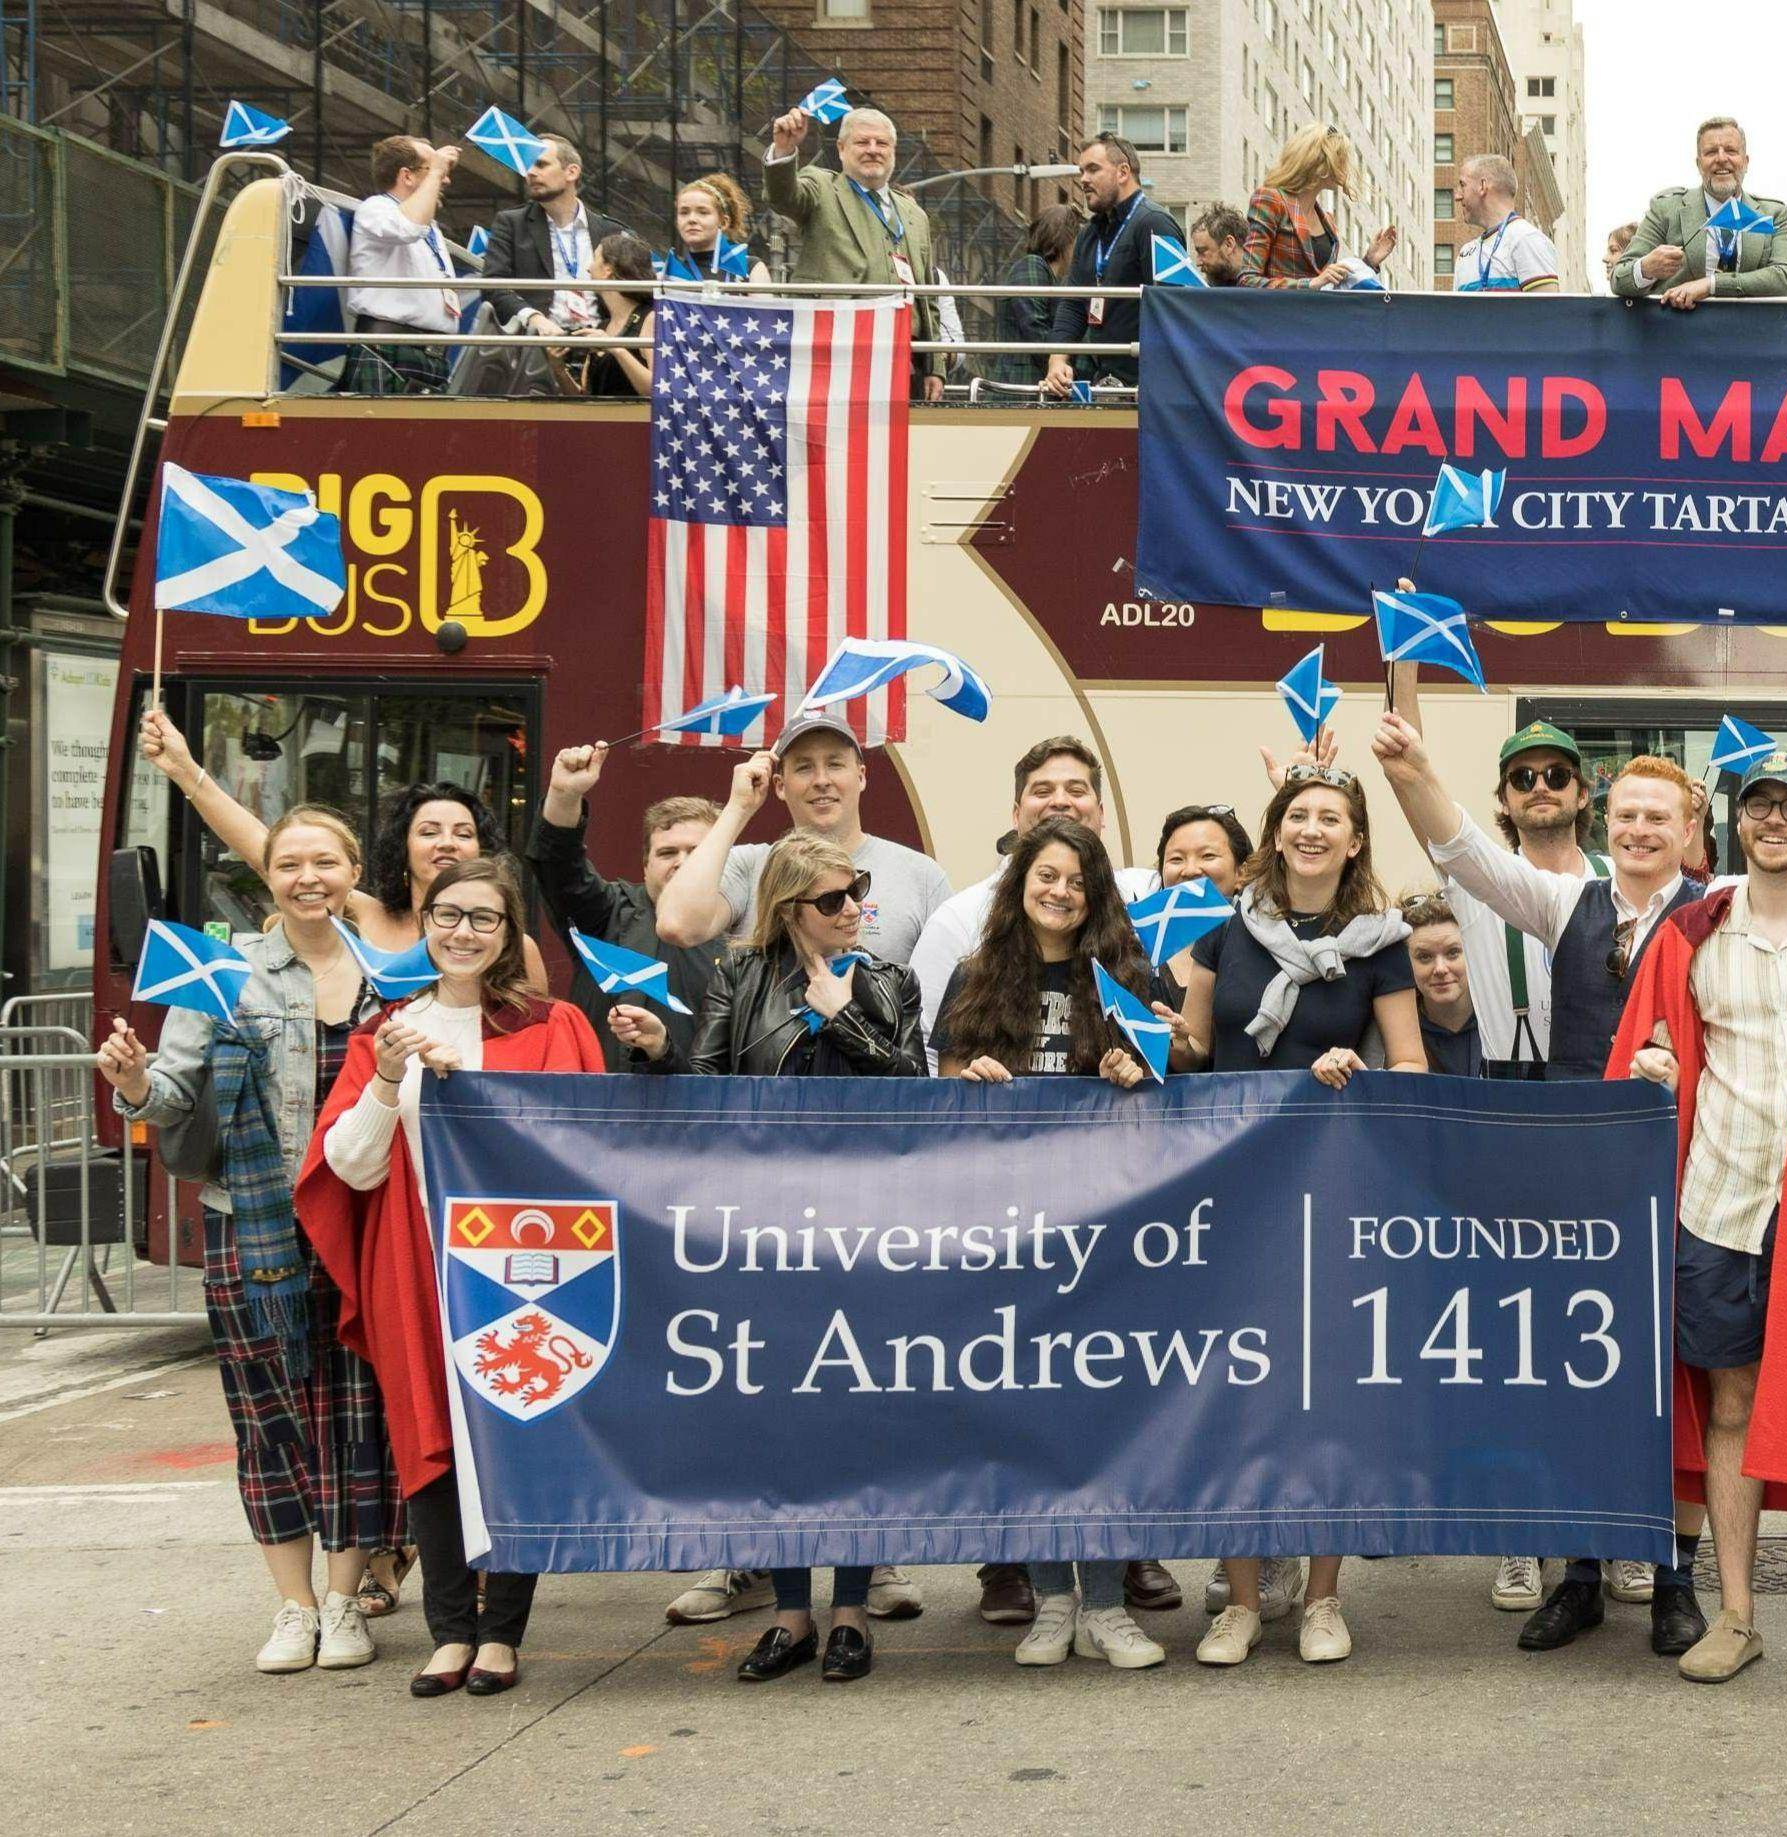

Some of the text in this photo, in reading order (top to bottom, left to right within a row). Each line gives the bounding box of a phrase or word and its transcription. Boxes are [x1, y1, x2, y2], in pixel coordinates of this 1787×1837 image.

[1224, 366, 1606, 457] GRAND
[1226, 477, 1346, 521] NEW
[1353, 486, 1499, 529] YO
[1512, 491, 1634, 530] CITY
[1100, 603, 1195, 626] ADL20
[666, 1198, 1213, 1294] University of
[1348, 1216, 1621, 1260] FOUNDED
[666, 1304, 1271, 1395] St Andrews
[1352, 1286, 1621, 1388] 1413
